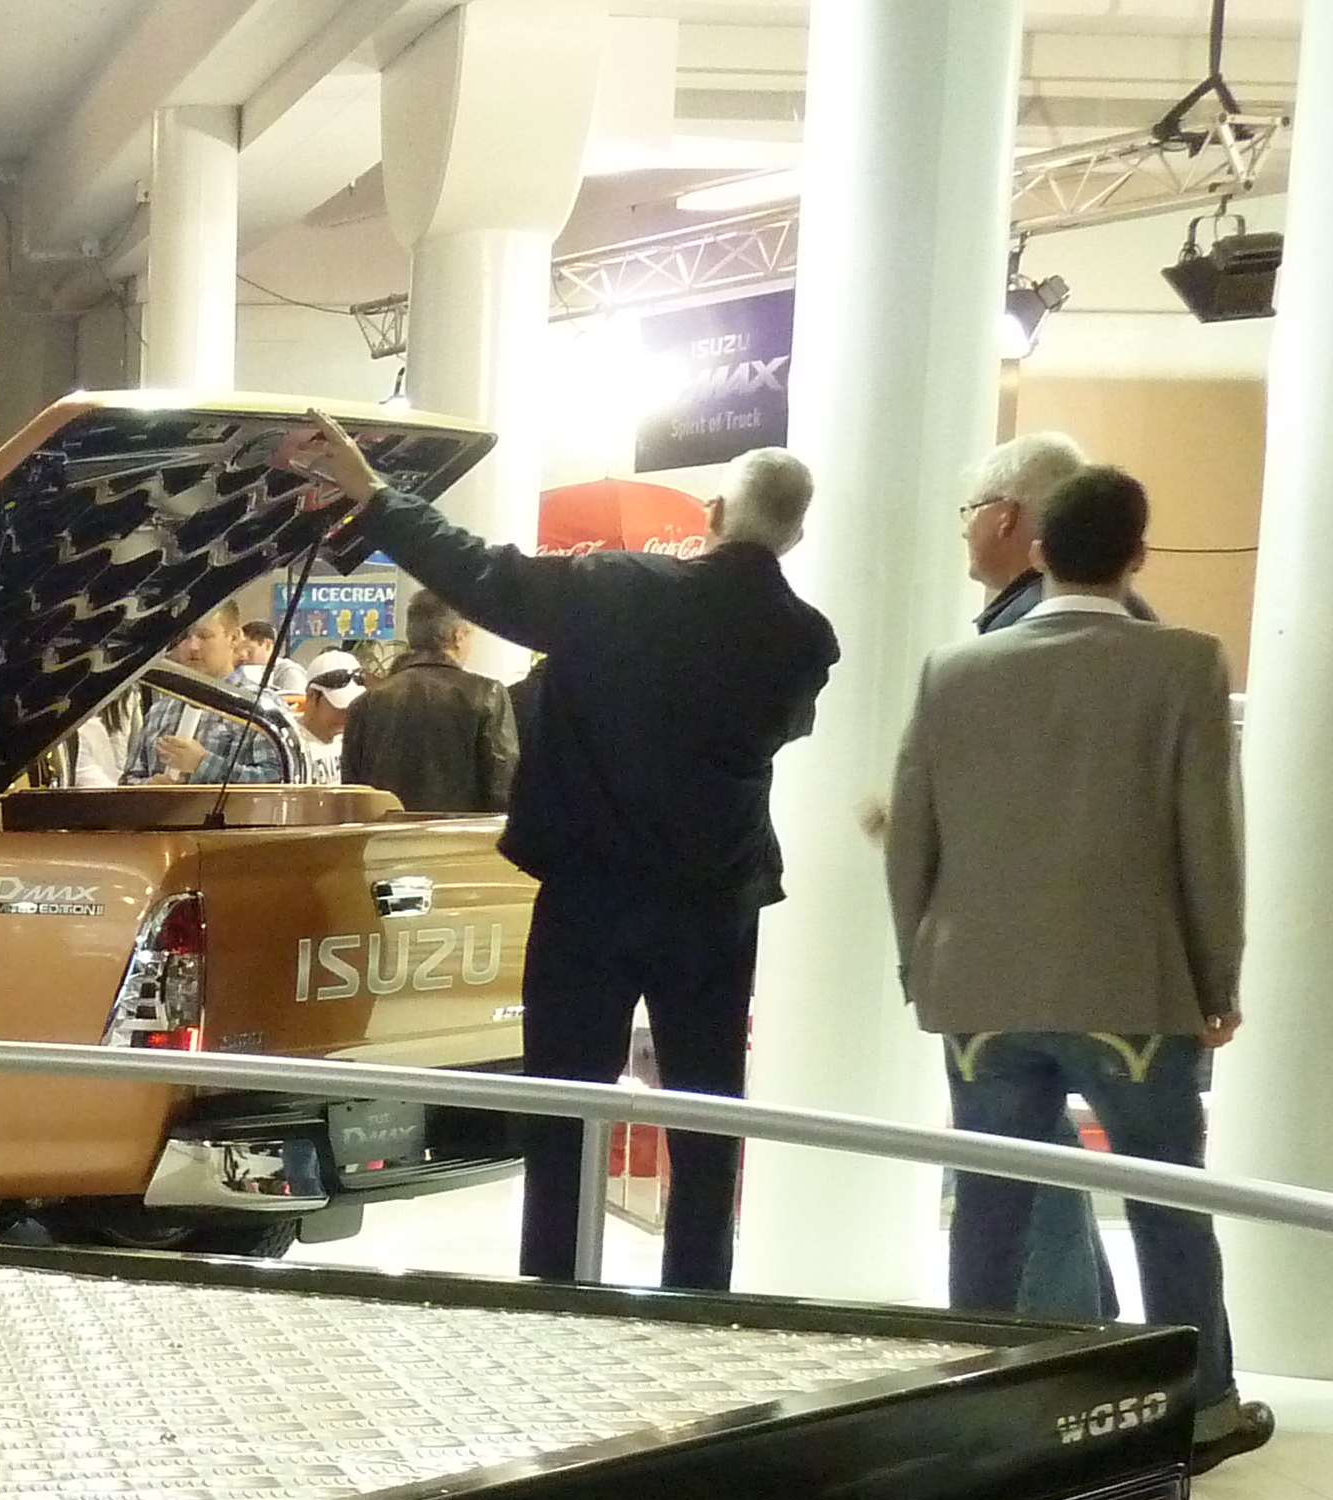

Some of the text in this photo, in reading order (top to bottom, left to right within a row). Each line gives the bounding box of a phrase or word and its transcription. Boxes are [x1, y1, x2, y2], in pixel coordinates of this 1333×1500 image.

[691, 333, 751, 357] ISUZU
[671, 408, 762, 440] Spirit of Truck
[39, 903, 96, 915] EDITION
[295, 922, 503, 1003] ISUZU
